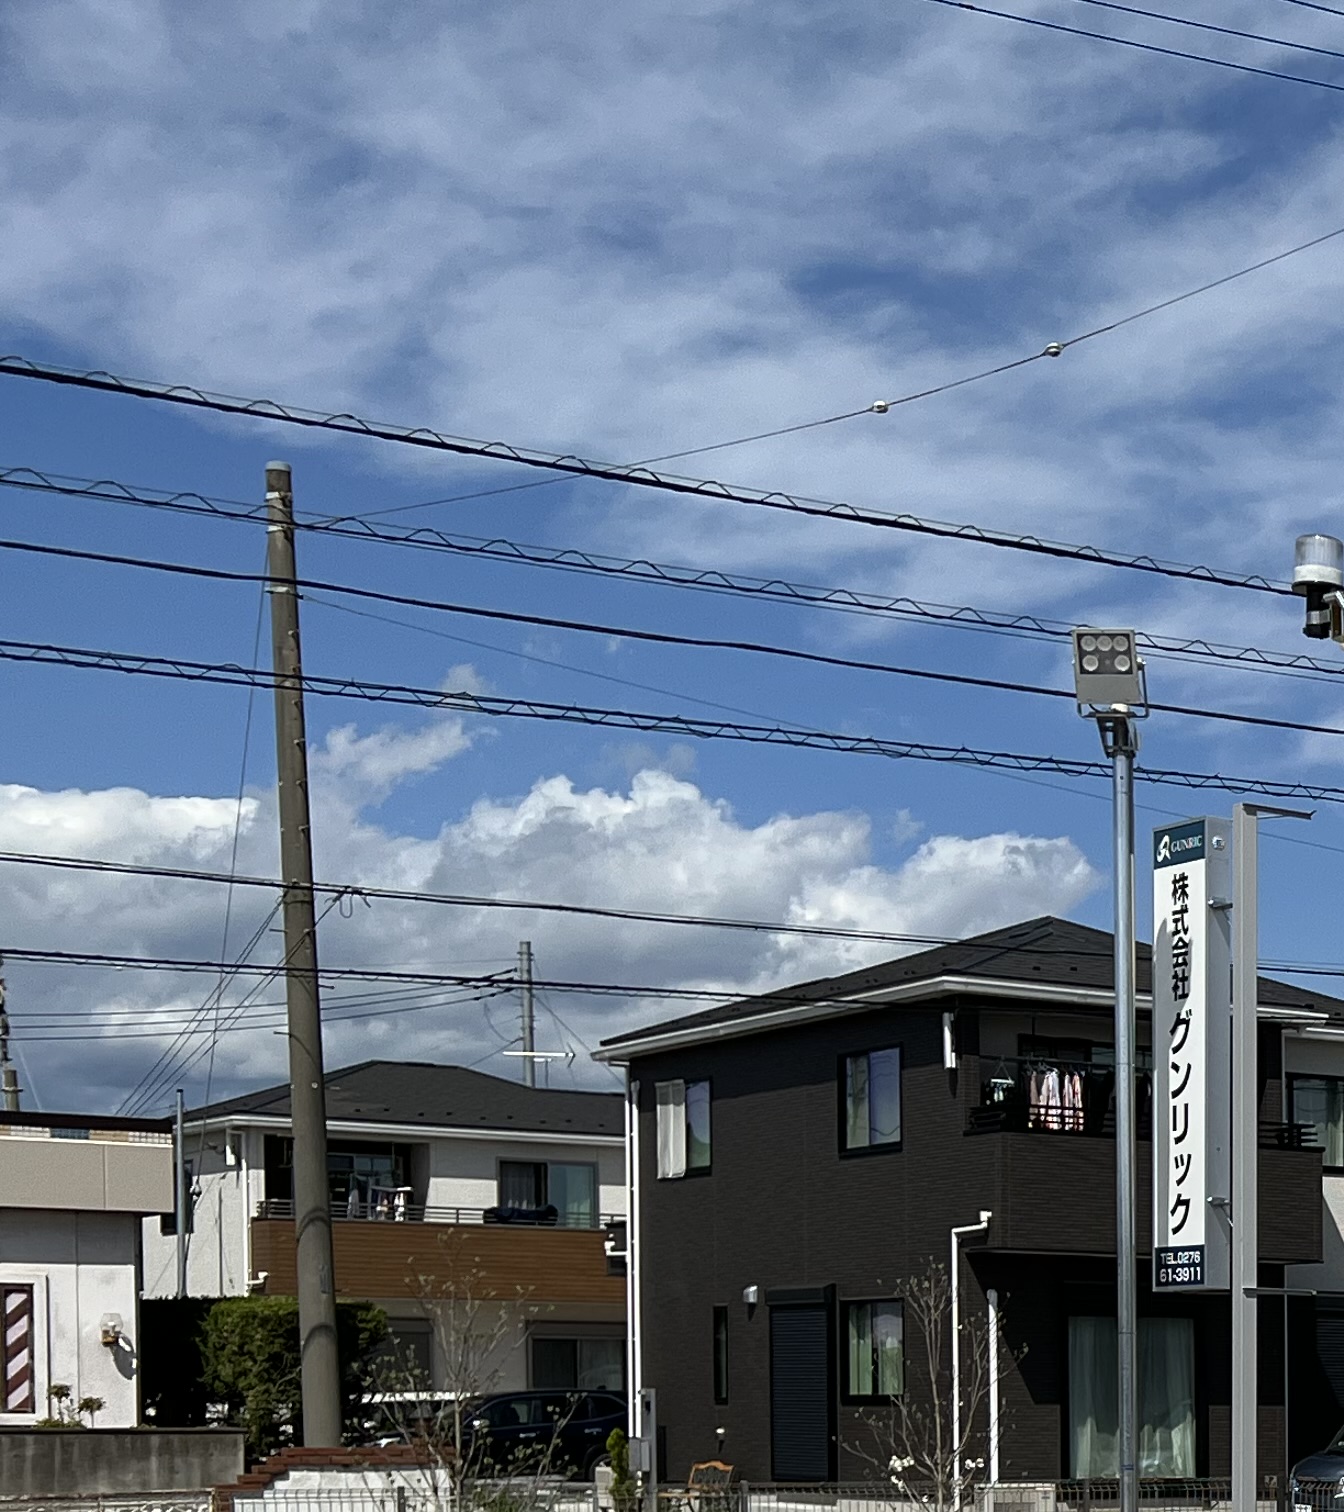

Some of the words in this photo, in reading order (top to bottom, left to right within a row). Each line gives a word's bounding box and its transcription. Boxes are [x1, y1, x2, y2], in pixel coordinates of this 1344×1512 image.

[1169, 872, 1193, 1236] 株式会社グンリック
[1160, 1266, 1201, 1283] 61-3911
